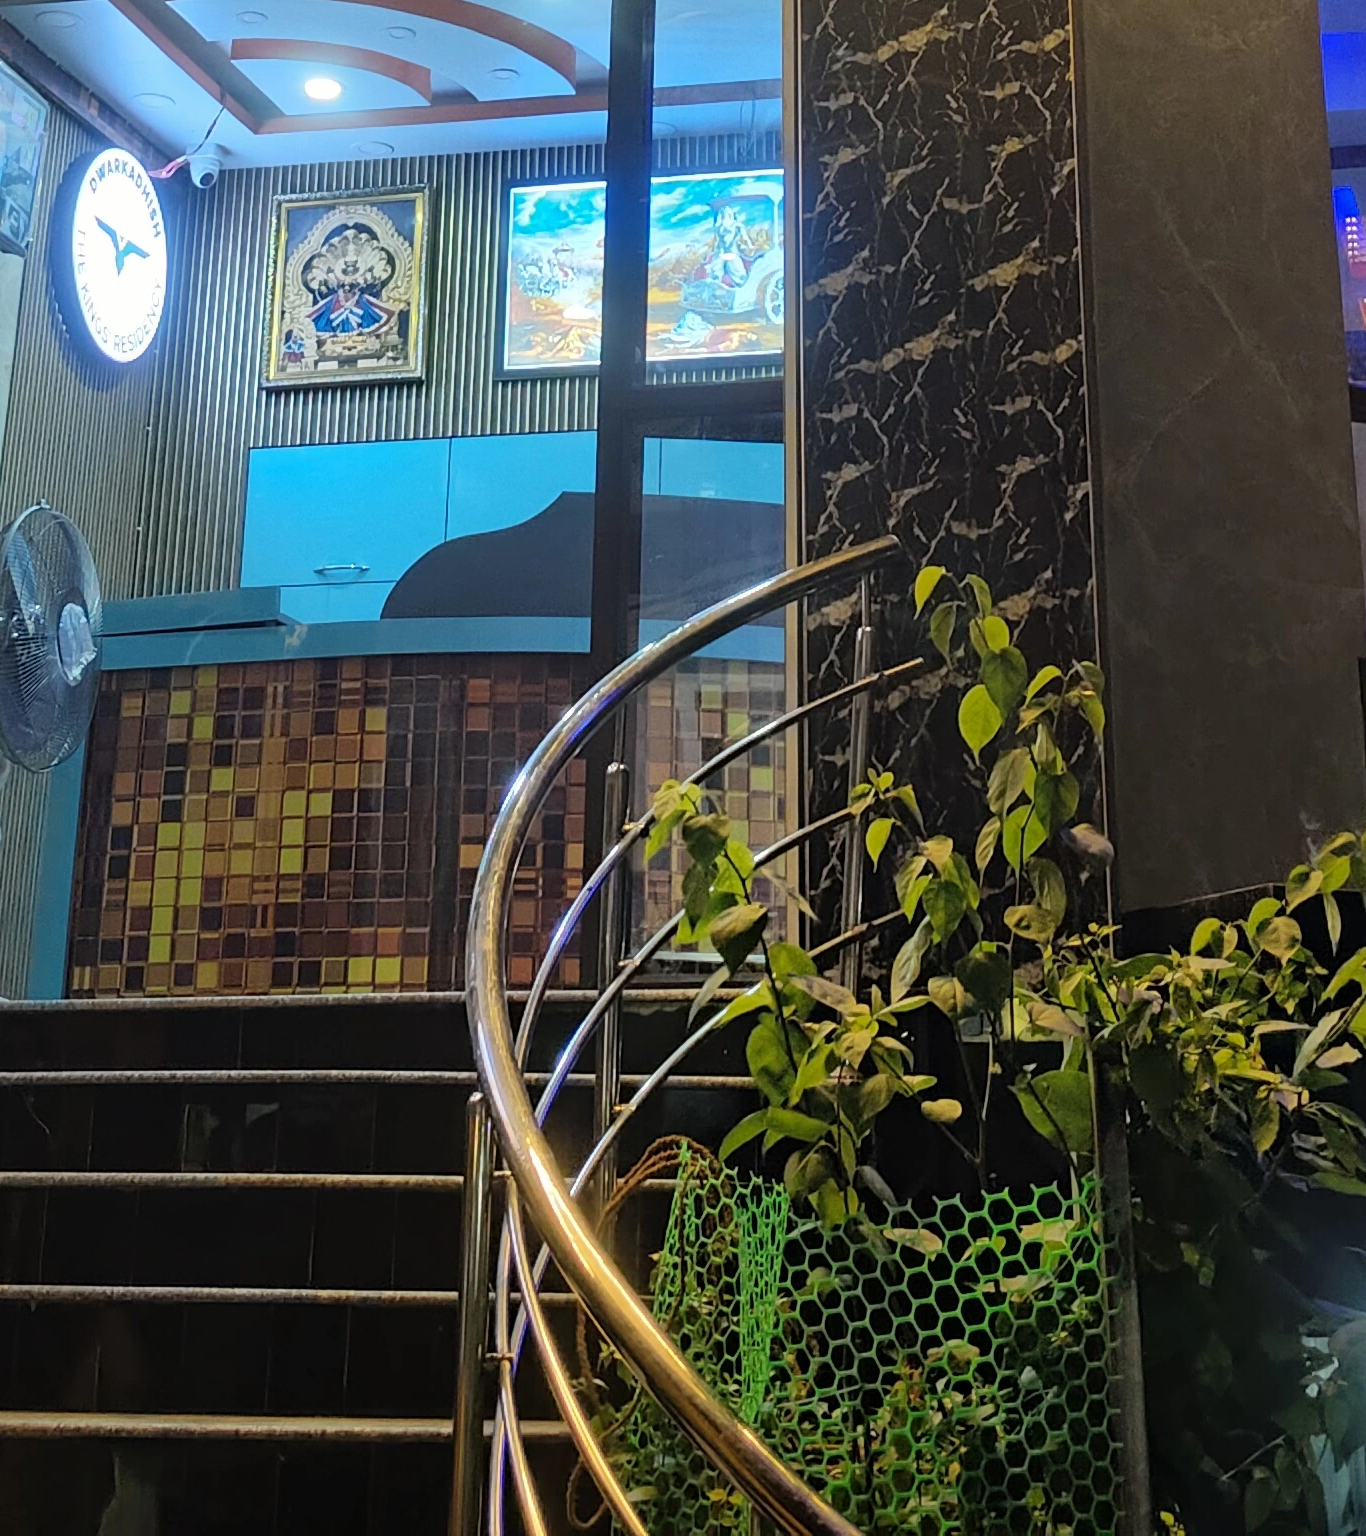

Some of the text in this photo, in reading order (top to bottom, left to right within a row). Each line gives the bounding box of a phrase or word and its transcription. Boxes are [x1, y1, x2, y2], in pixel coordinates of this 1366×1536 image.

[89, 157, 161, 238] DWARKADHISH
[77, 229, 87, 274] THE
[114, 279, 161, 353] RESIDENCY
